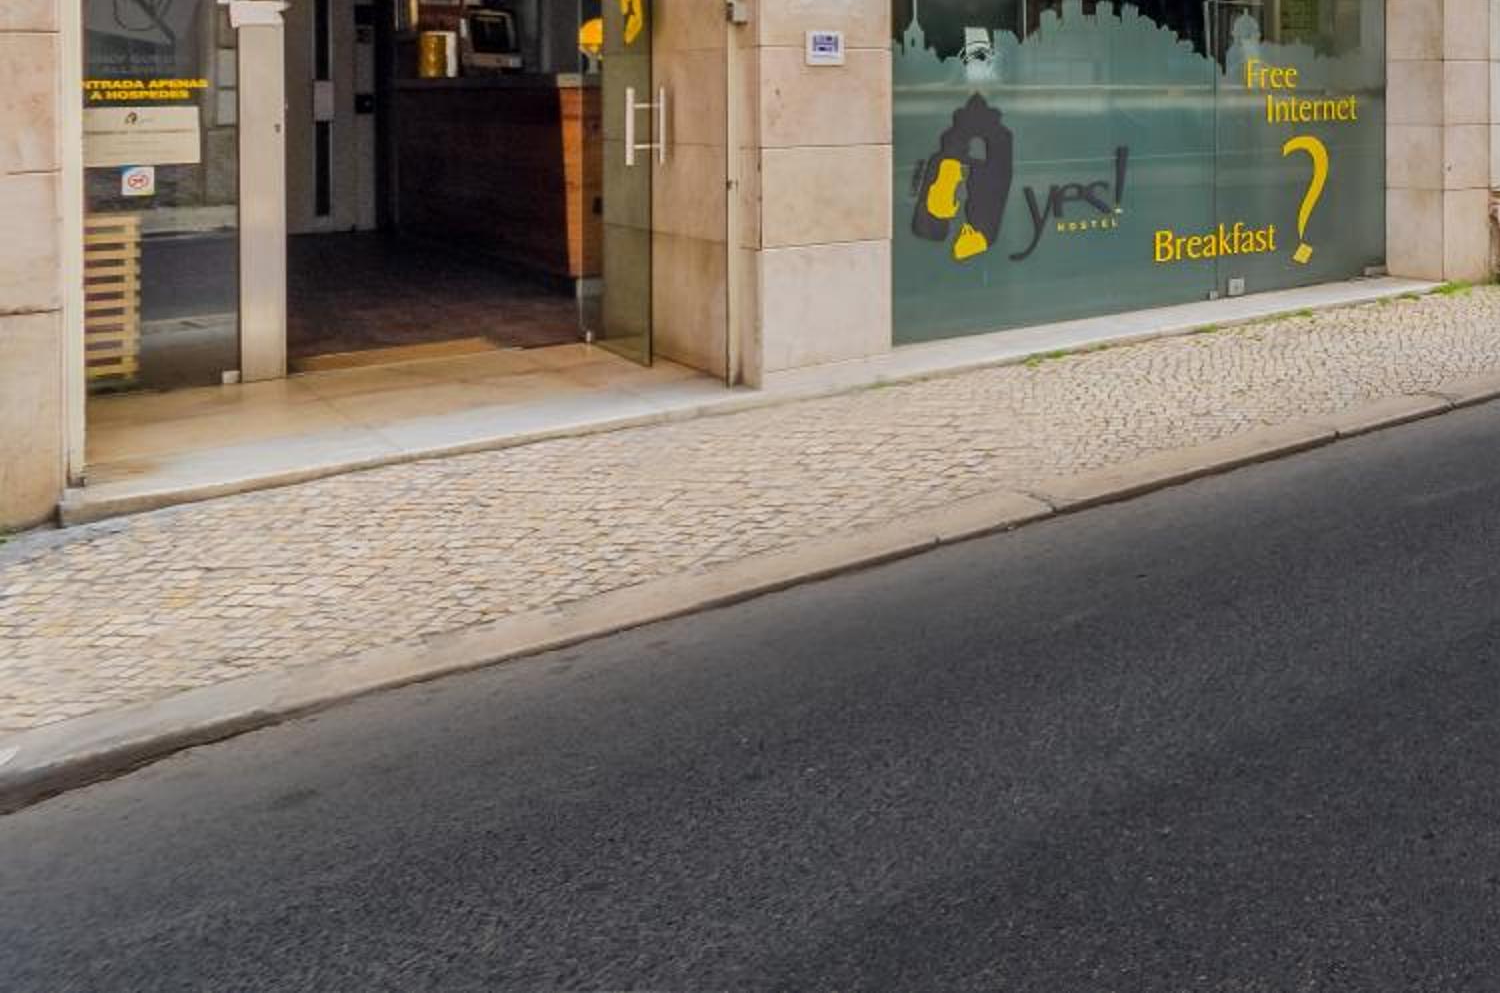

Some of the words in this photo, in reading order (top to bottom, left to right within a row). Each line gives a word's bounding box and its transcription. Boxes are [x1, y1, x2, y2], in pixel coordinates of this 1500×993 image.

[83, 78, 145, 90] NTRADA
[148, 78, 210, 89] APENAS
[1245, 58, 1298, 89] Free
[90, 90, 102, 100] A
[1266, 94, 1358, 124] Internet
[1009, 145, 1129, 262] yes!
[1281, 135, 1329, 264] ?
[1056, 218, 1118, 232] HOSTEL
[1155, 222, 1277, 263] Breakfast
